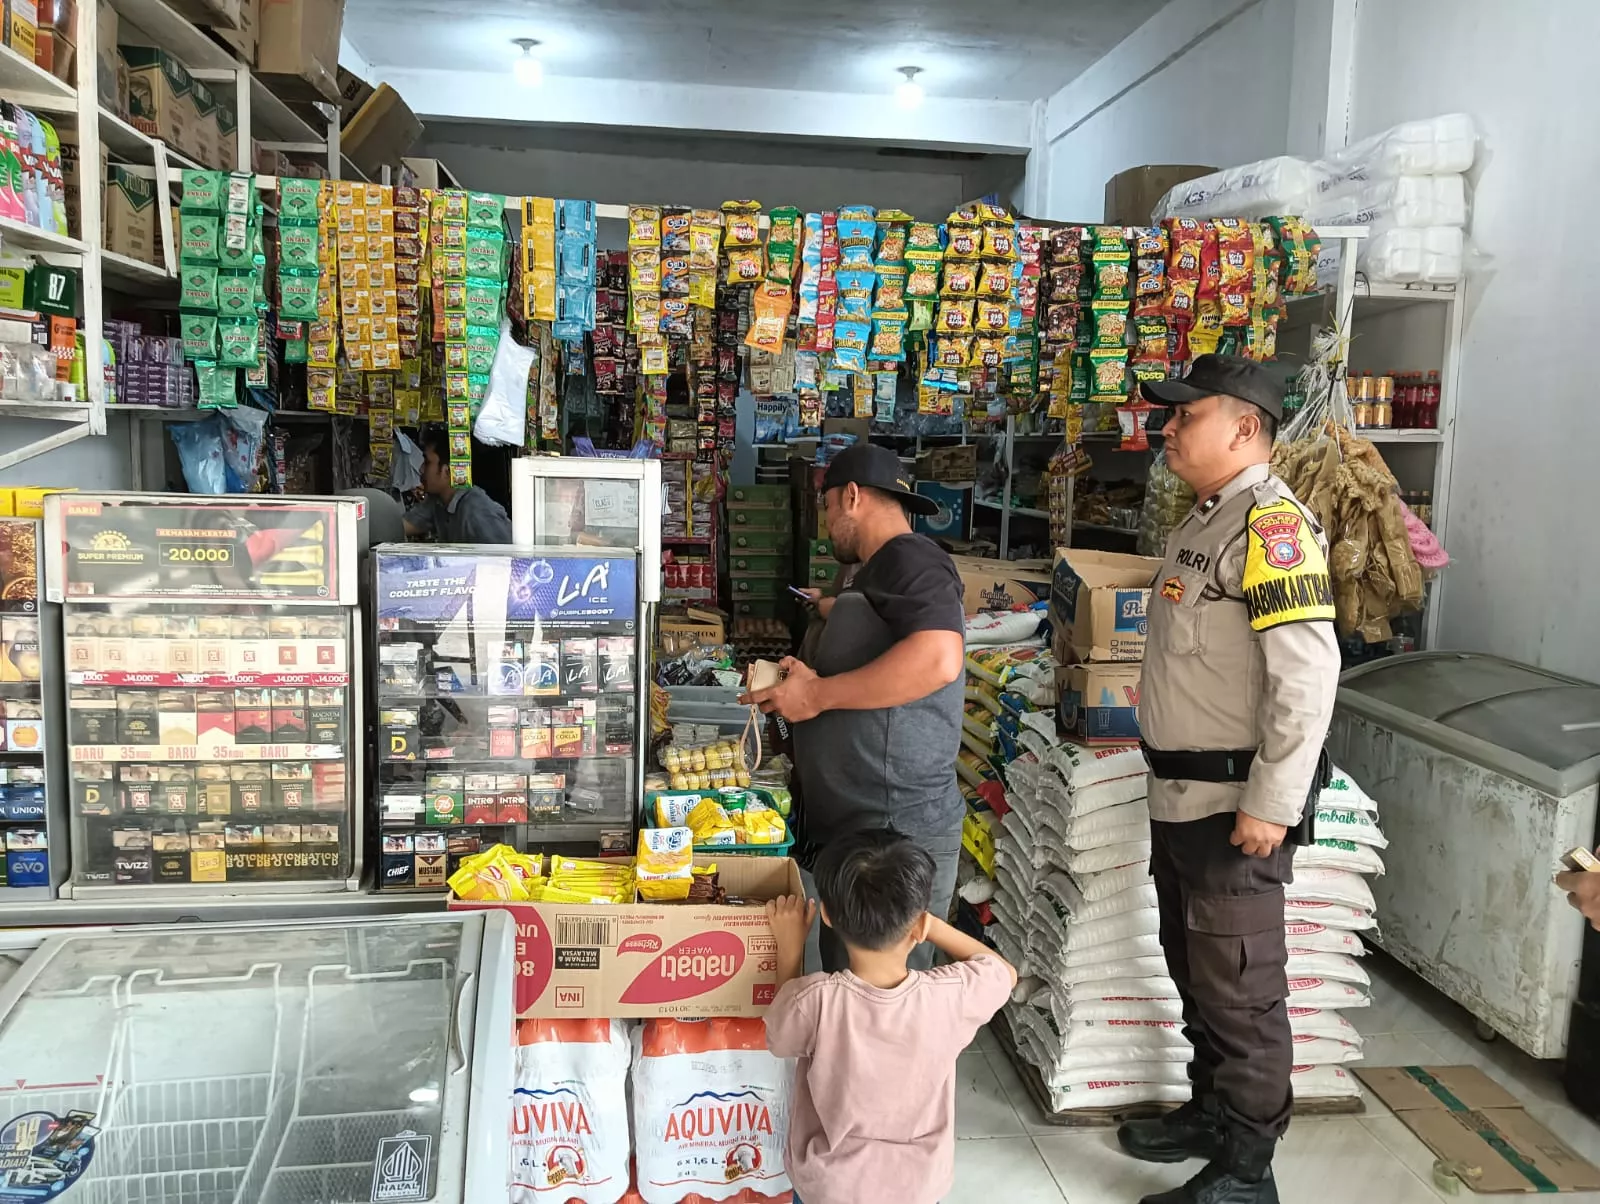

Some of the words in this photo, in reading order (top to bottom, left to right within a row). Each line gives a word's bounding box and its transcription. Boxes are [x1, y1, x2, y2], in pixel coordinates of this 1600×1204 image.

[48, 273, 66, 301] 87
[1138, 324, 1167, 334] Rosta
[1137, 370, 1165, 380] Rosta
[757, 402, 787, 413] Happily
[77, 552, 105, 560] SUPER
[107, 552, 144, 561] PREMIUM
[169, 548, 230, 562] 20.000
[1176, 548, 1210, 573] POLRI
[406, 578, 440, 588] TASTE
[444, 576, 467, 585] THE
[389, 588, 437, 598] COOLEST
[440, 586, 476, 596] FLAVO
[391, 736, 407, 753] D
[75, 748, 104, 759] BARU
[168, 747, 197, 759] BARU
[260, 746, 289, 757] BARU
[86, 789, 100, 803] D
[468, 797, 494, 805] INTRO
[12, 805, 43, 815] UNION
[12, 861, 44, 874] evo
[116, 861, 149, 870] TWIZZ
[387, 865, 410, 877] CHIEF
[418, 866, 443, 875] MUSTANG
[624, 938, 659, 950] Richeese
[679, 946, 713, 954] WAFER
[660, 955, 735, 981] nabati
[560, 992, 580, 1001] INA
[513, 1102, 592, 1135] UVIVA
[664, 1103, 773, 1142] AQUVIVA
[379, 1181, 420, 1192] HALAL
